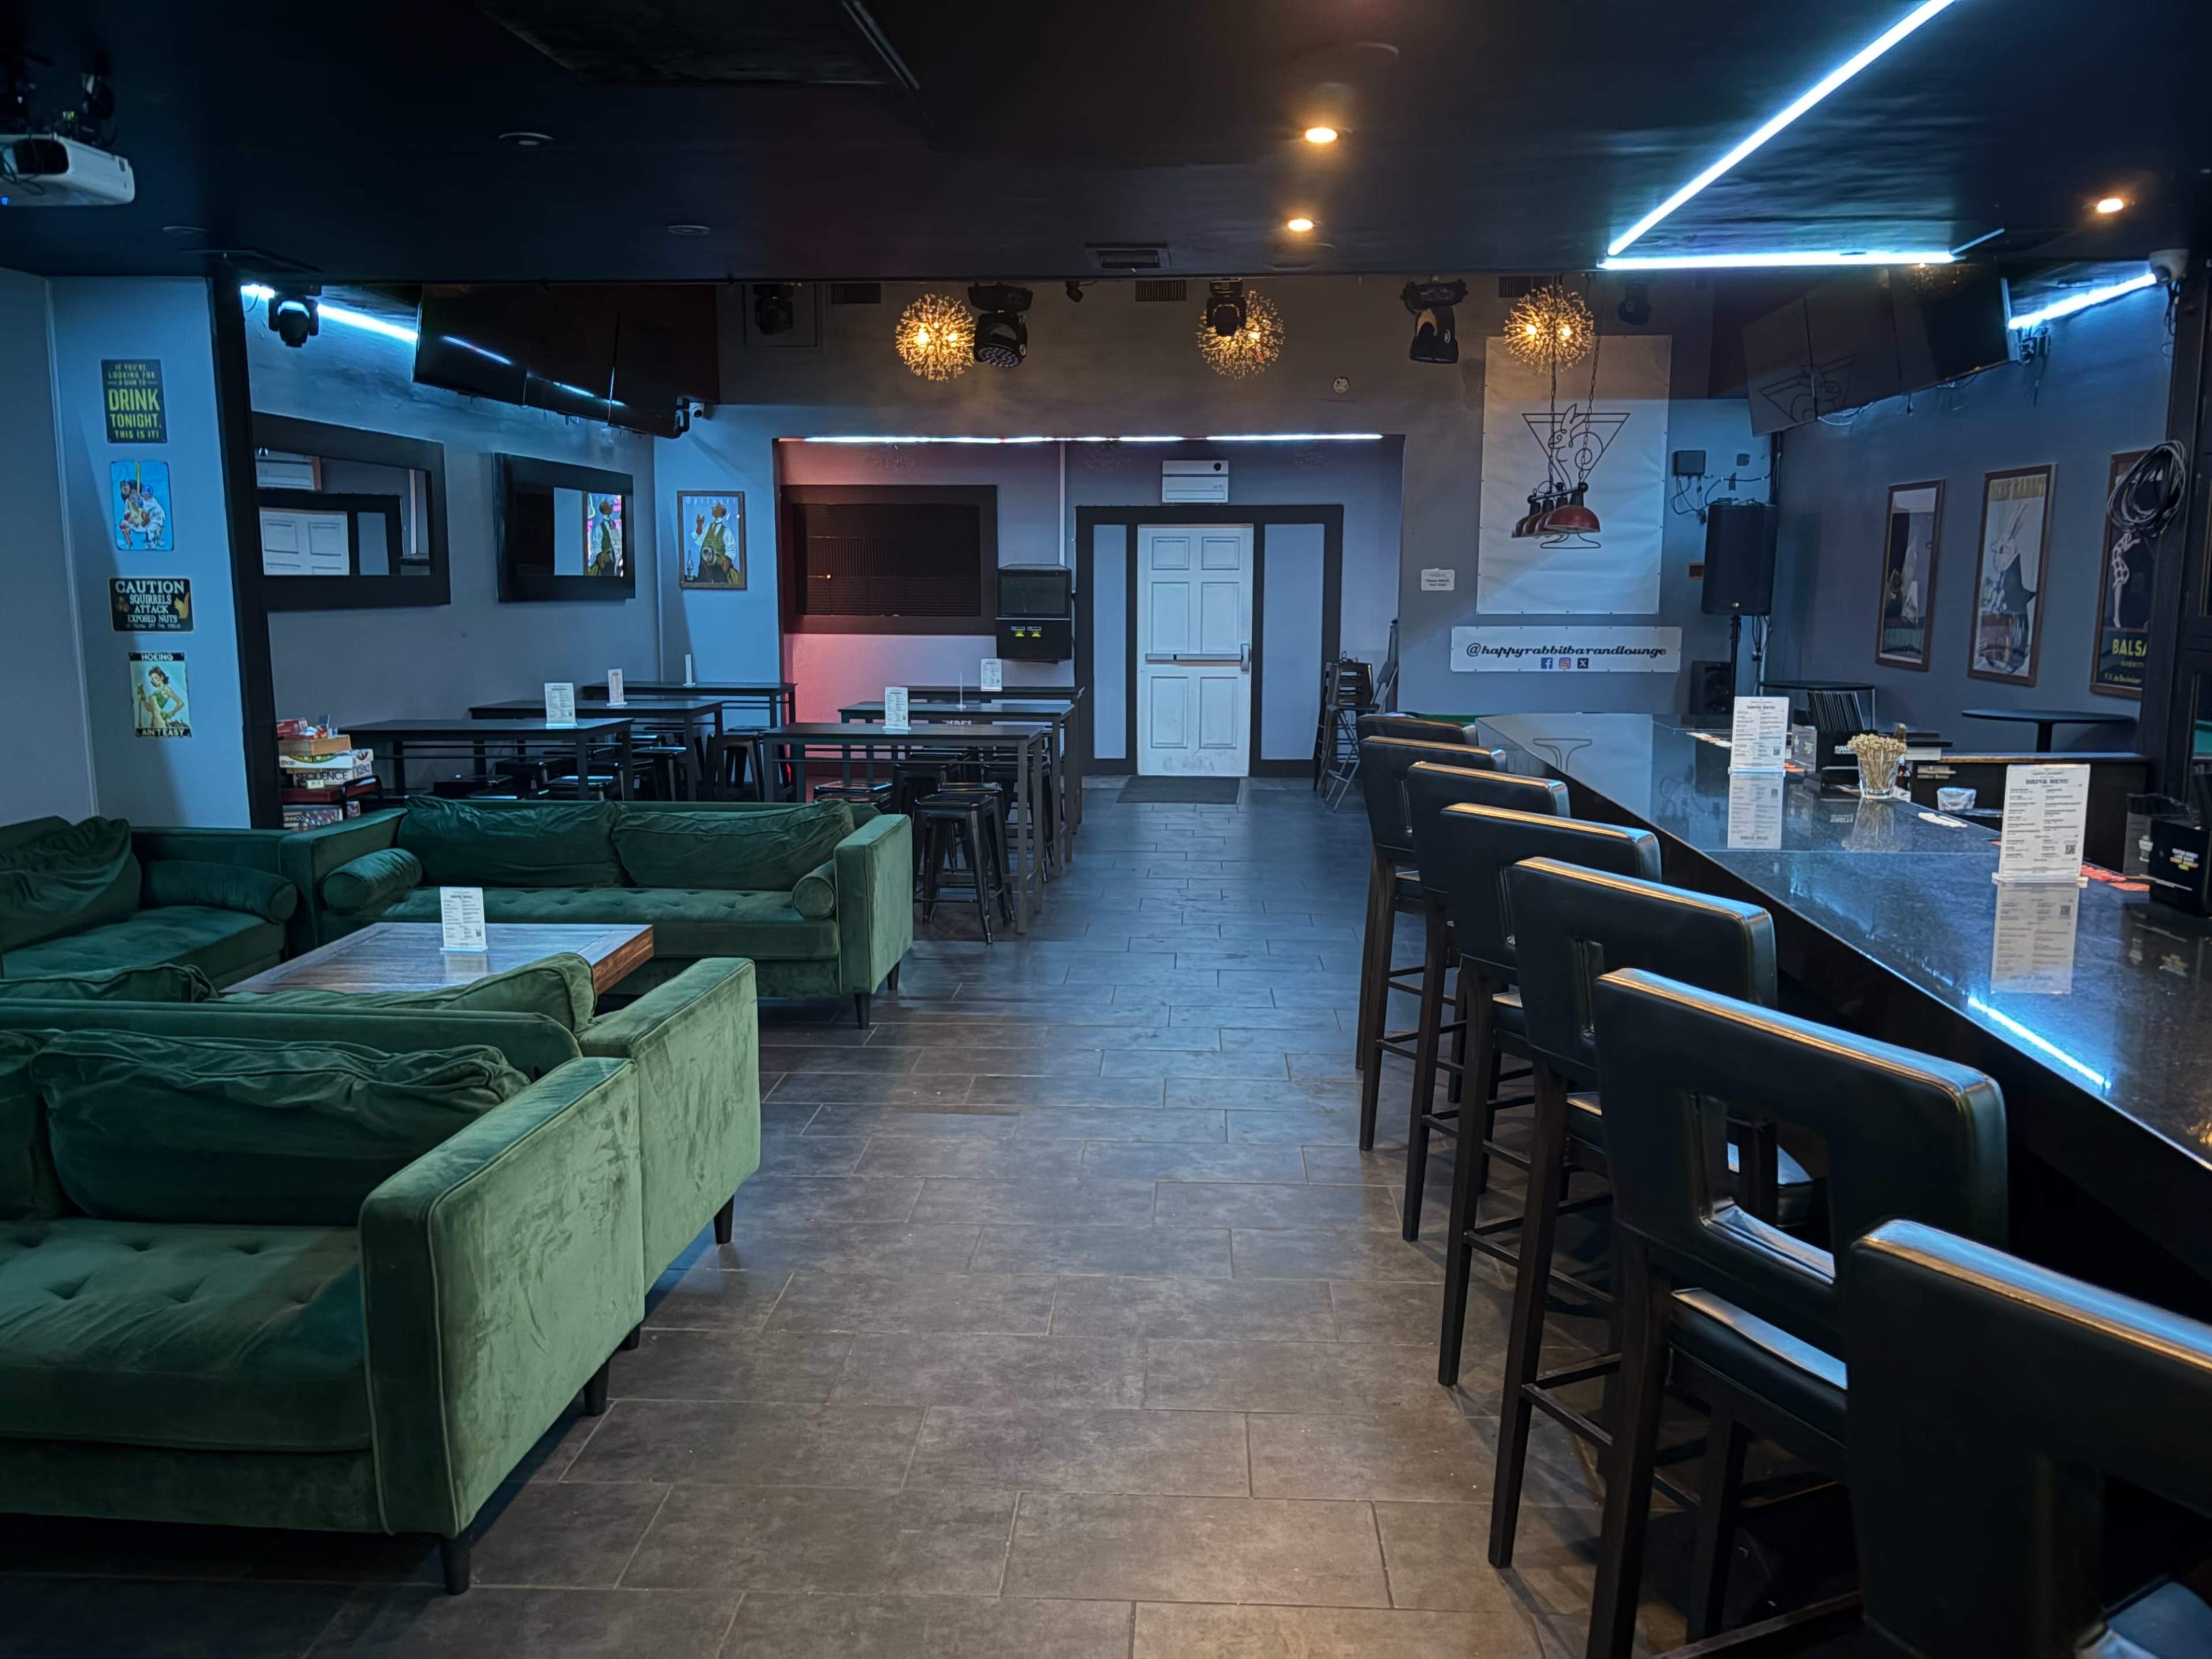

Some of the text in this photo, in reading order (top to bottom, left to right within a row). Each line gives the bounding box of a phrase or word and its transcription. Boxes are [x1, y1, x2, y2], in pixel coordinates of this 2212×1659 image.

[108, 388, 160, 411] DRINK
[115, 430, 160, 438] THIS IS IT!
[115, 580, 184, 594] CAUTION
[130, 593, 172, 605] SQUIRRELS
[134, 604, 169, 613] ATTACK
[128, 614, 177, 623] EXPOSED NUTS
[1466, 642, 1666, 658] @happyrabbitbarandlounge
